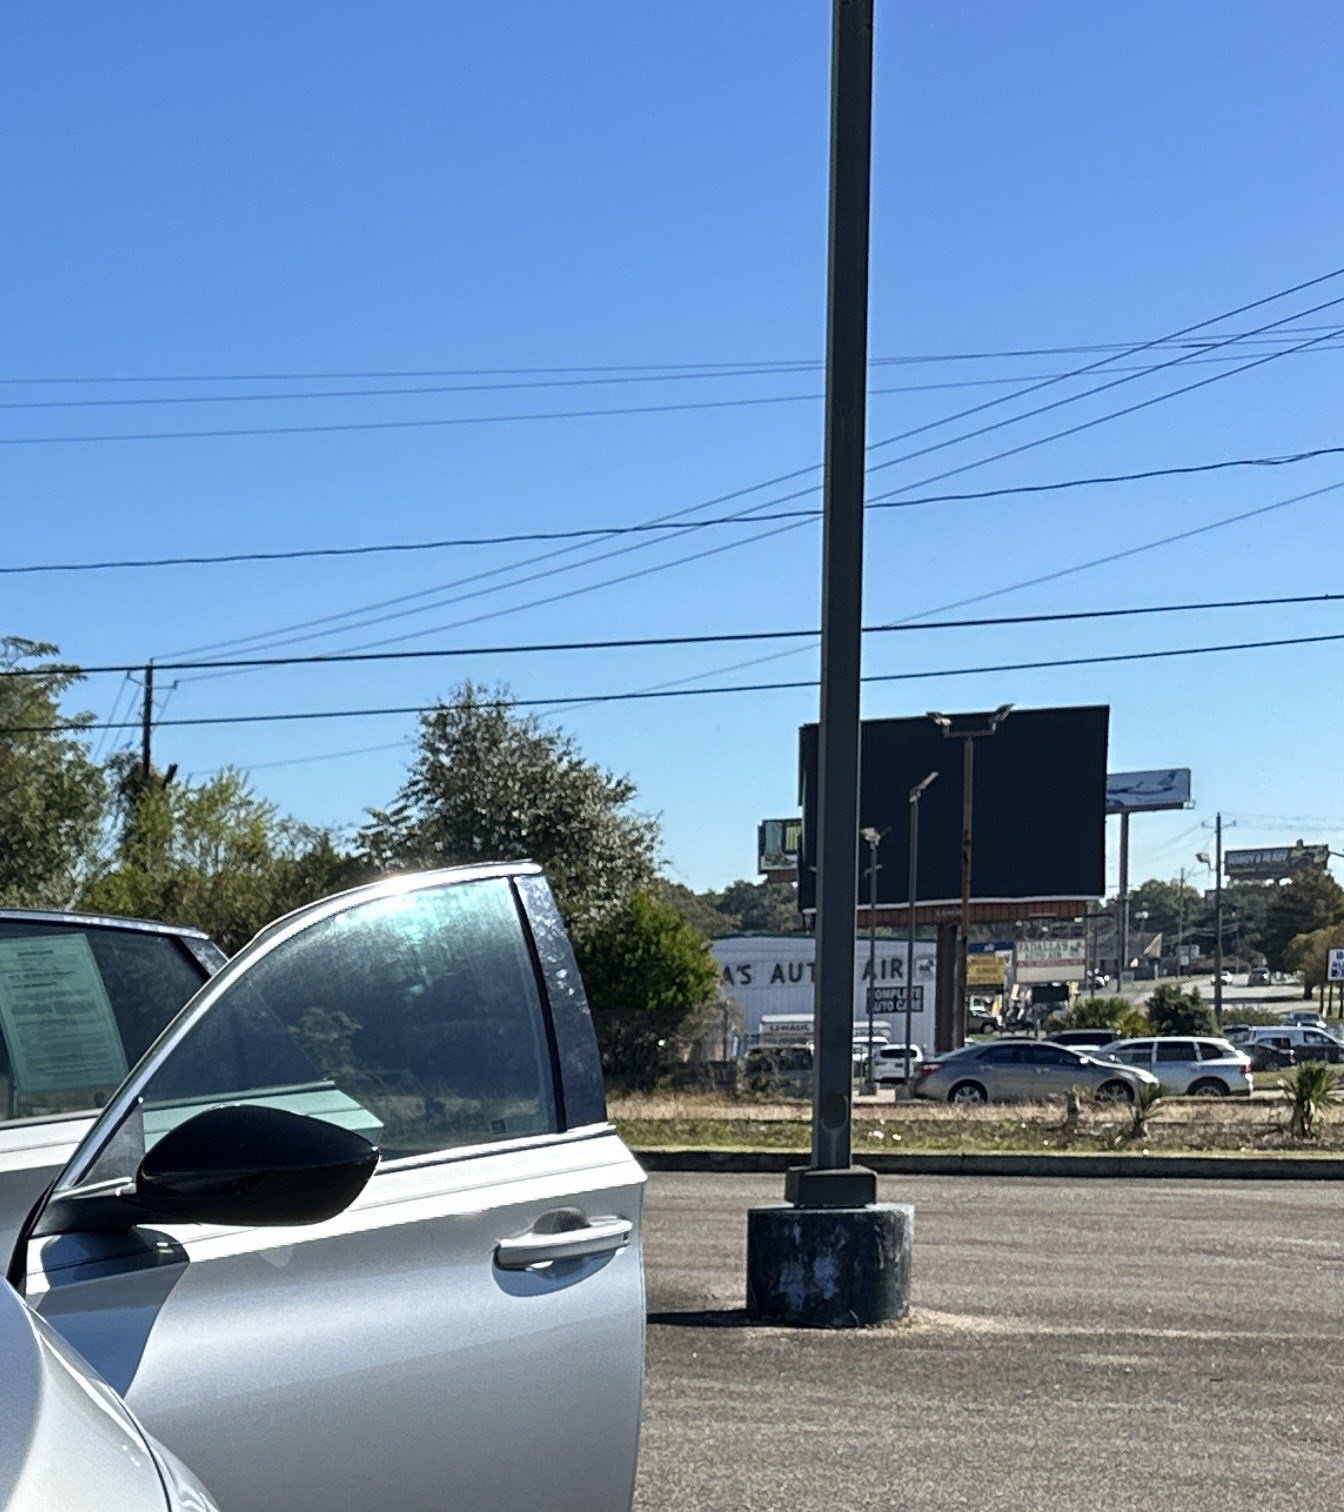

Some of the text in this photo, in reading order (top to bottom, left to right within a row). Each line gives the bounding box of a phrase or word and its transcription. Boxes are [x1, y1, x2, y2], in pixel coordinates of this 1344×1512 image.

[770, 962, 815, 984] AUT
[862, 957, 903, 980] AIR
[868, 988, 922, 1000] OMPLETE
[870, 1000, 895, 1012] UTO
